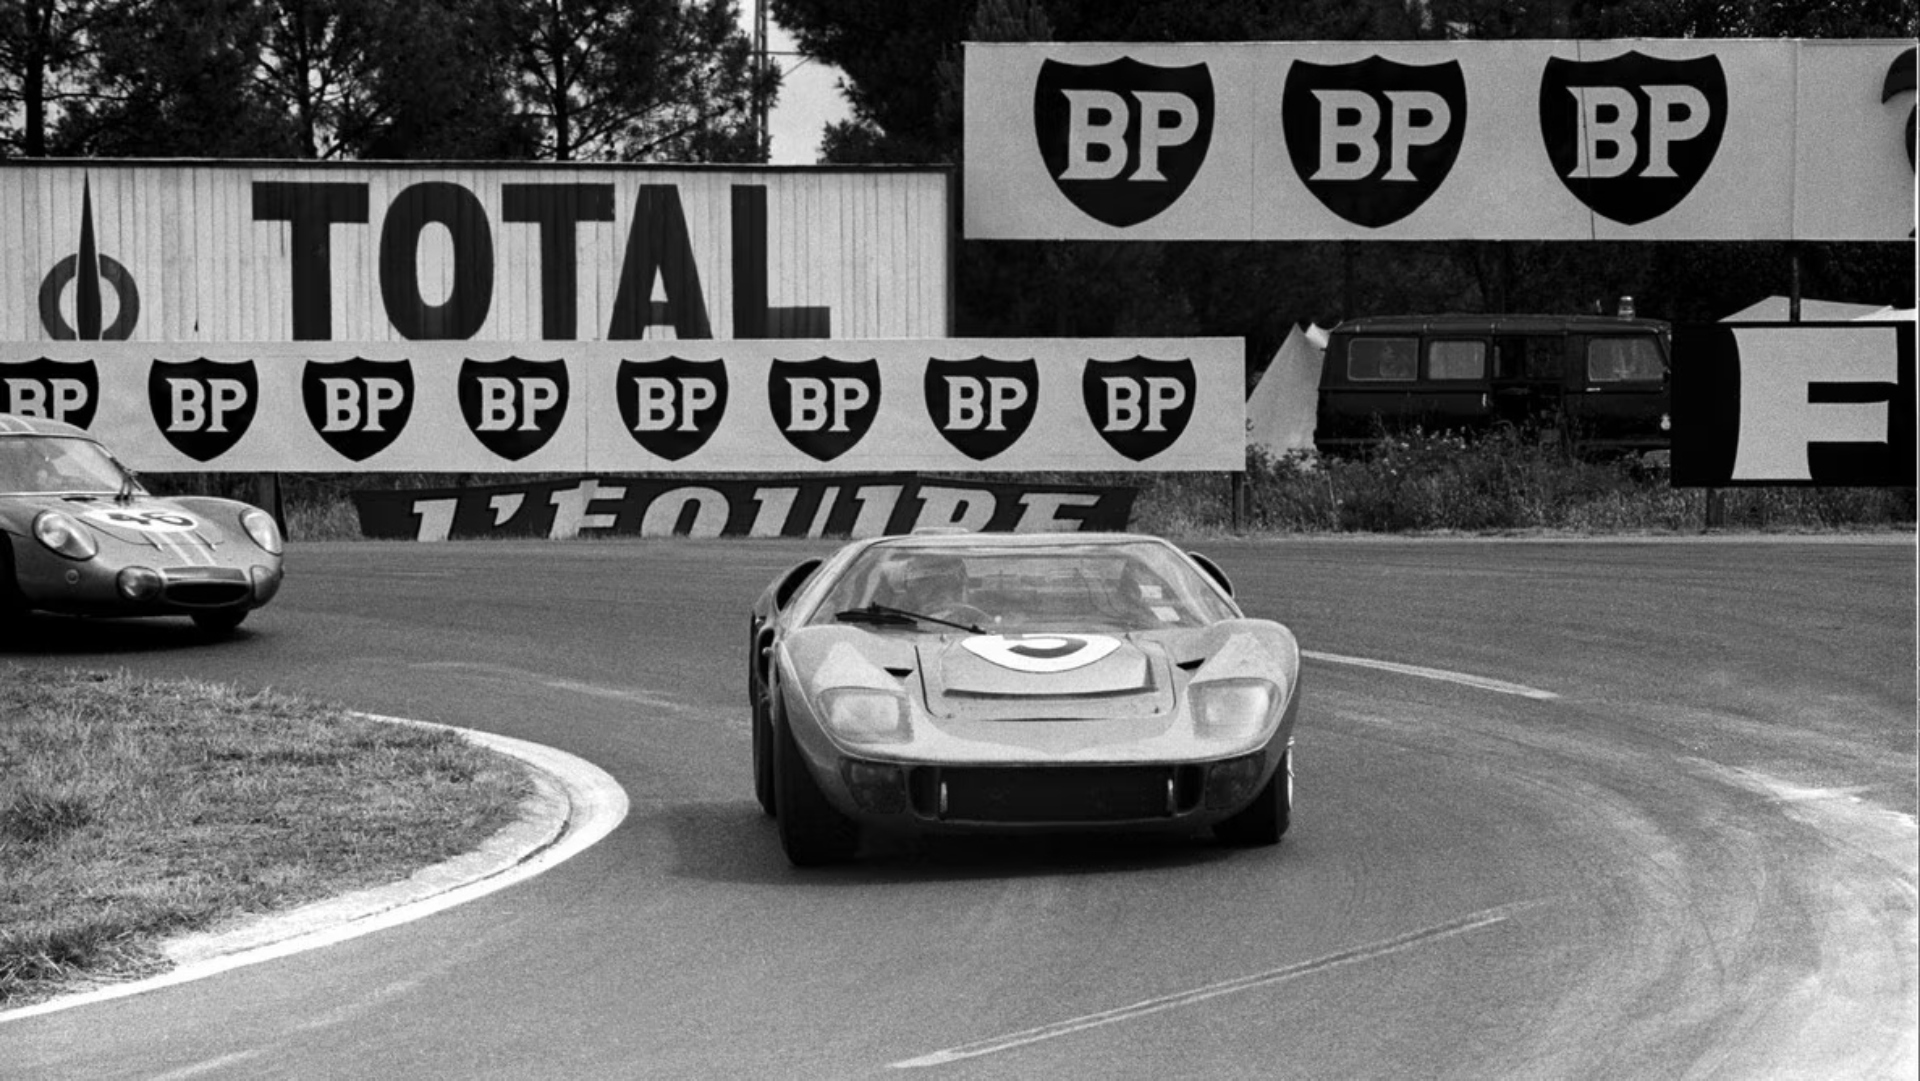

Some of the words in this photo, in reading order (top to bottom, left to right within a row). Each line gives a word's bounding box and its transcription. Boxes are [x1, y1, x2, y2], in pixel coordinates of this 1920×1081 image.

[1058, 89, 1199, 181] BP
[1309, 89, 1451, 181] BP
[1566, 85, 1711, 178] BP
[252, 181, 831, 340] TOTAL
[3, 377, 89, 421] BP
[165, 377, 248, 432] BP
[320, 377, 404, 432] BP
[476, 376, 559, 431] BP
[633, 377, 717, 432] BP
[785, 377, 870, 432] BP
[943, 375, 1028, 431] BP
[1101, 376, 1186, 432] BP
[1731, 326, 1899, 480] F
[1003, 633, 1088, 659] 5
